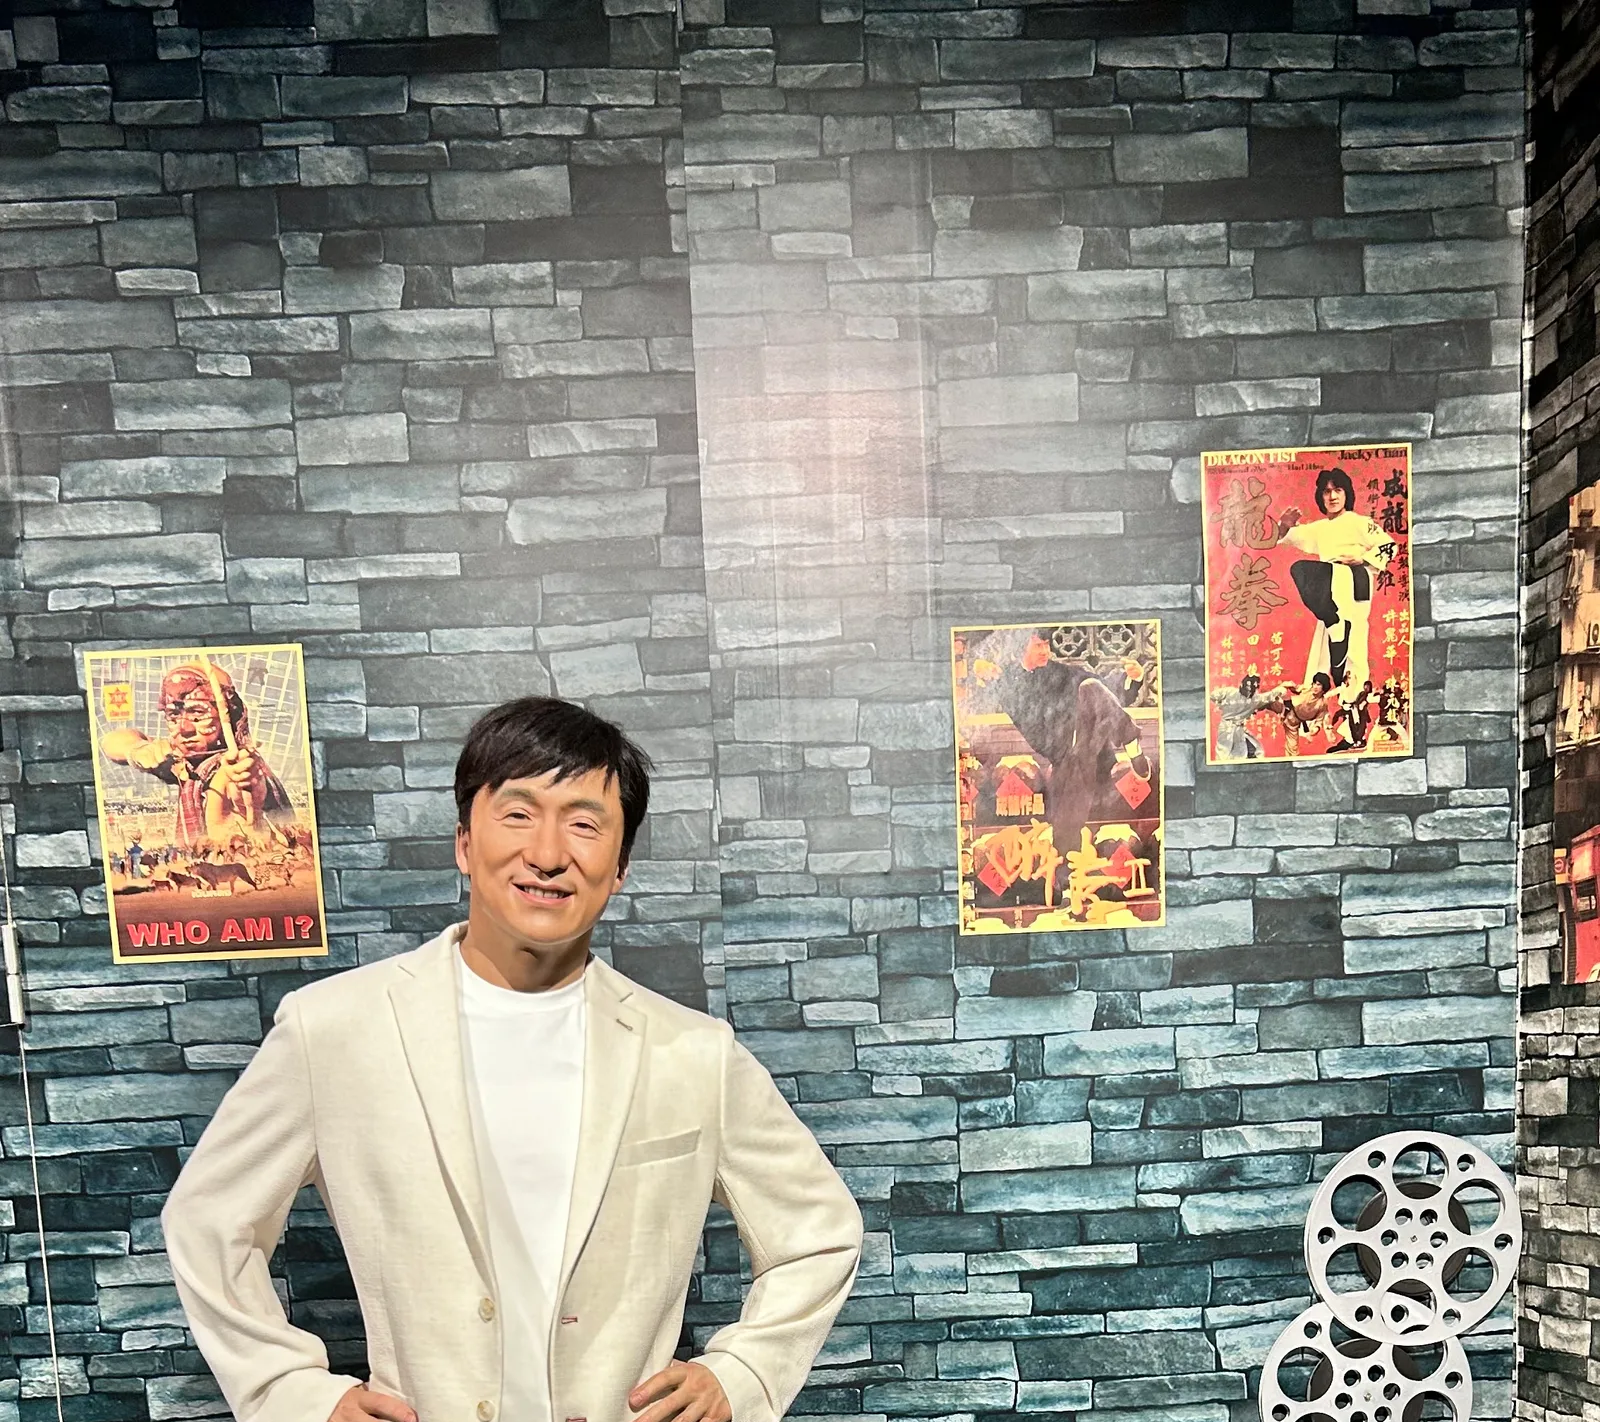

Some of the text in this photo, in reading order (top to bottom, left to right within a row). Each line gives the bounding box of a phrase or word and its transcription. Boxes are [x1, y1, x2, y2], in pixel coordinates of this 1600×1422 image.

[1207, 452, 1264, 467] DRAGON
[1269, 451, 1298, 463] FIST
[1338, 449, 1372, 461] Jacky
[1210, 475, 1289, 630] 龍拳
[126, 914, 314, 948] WHO AM I?
